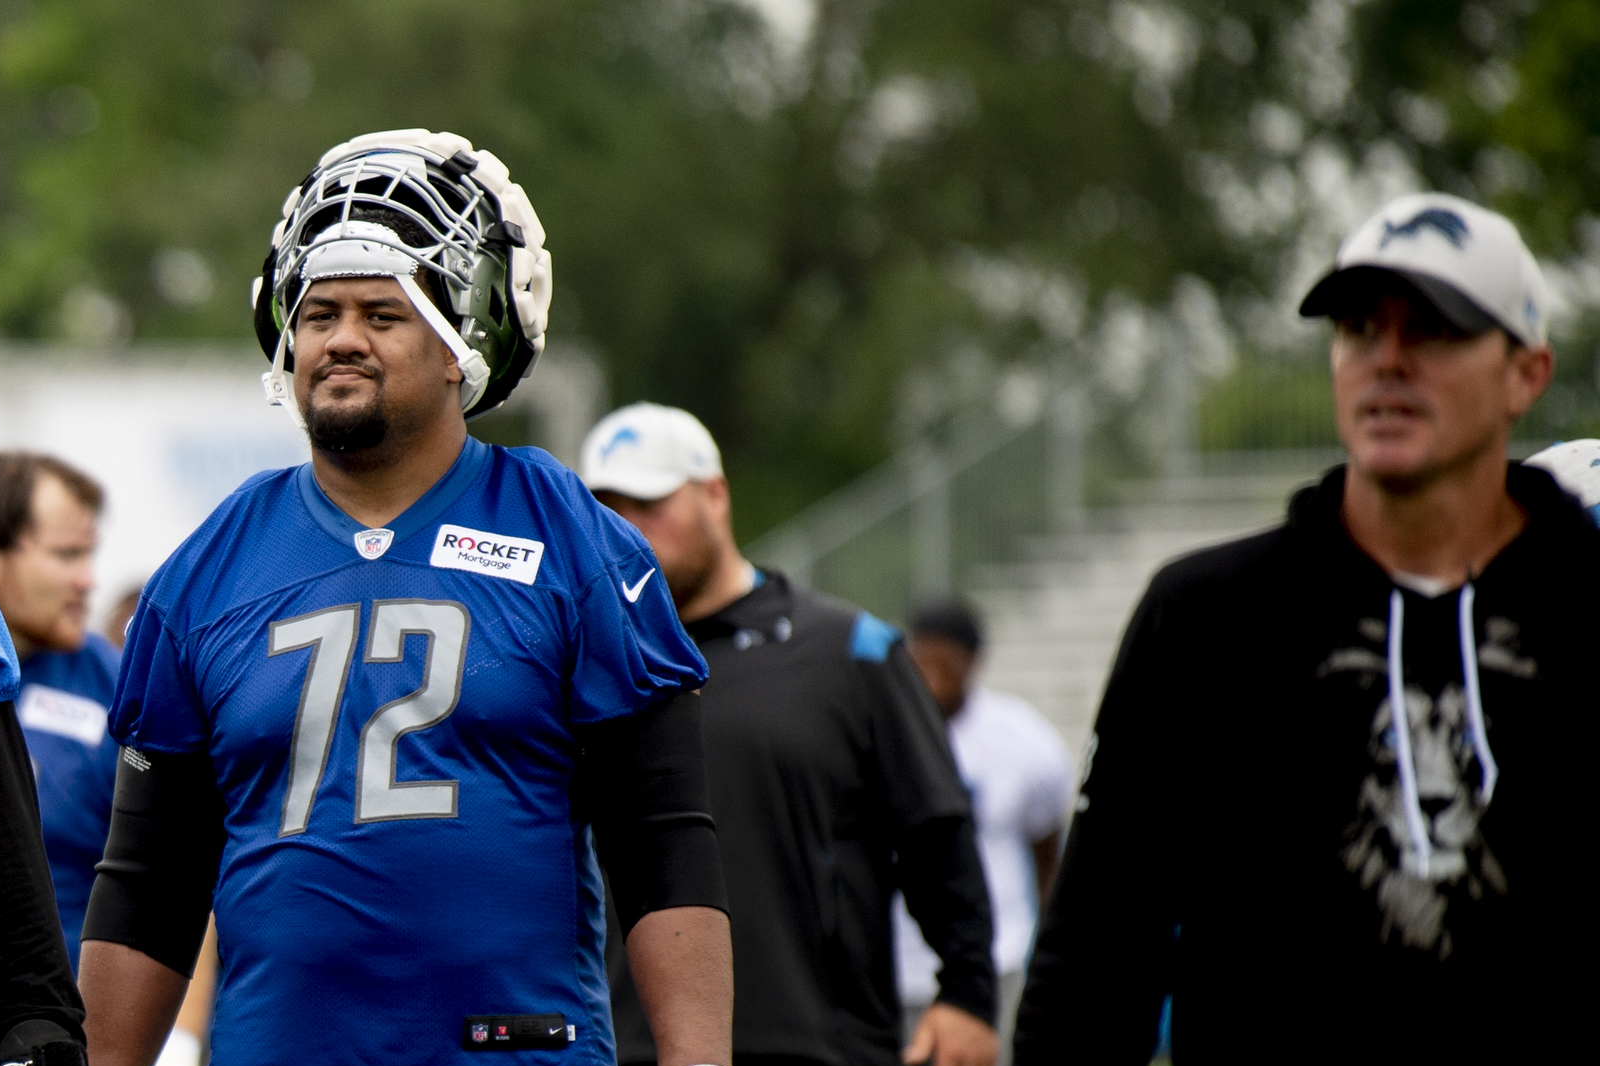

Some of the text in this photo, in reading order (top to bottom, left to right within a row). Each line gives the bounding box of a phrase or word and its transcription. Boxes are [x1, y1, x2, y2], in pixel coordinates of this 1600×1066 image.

[442, 533, 535, 562] ROCKET
[457, 551, 511, 570] Mortgage
[268, 597, 472, 838] 72
